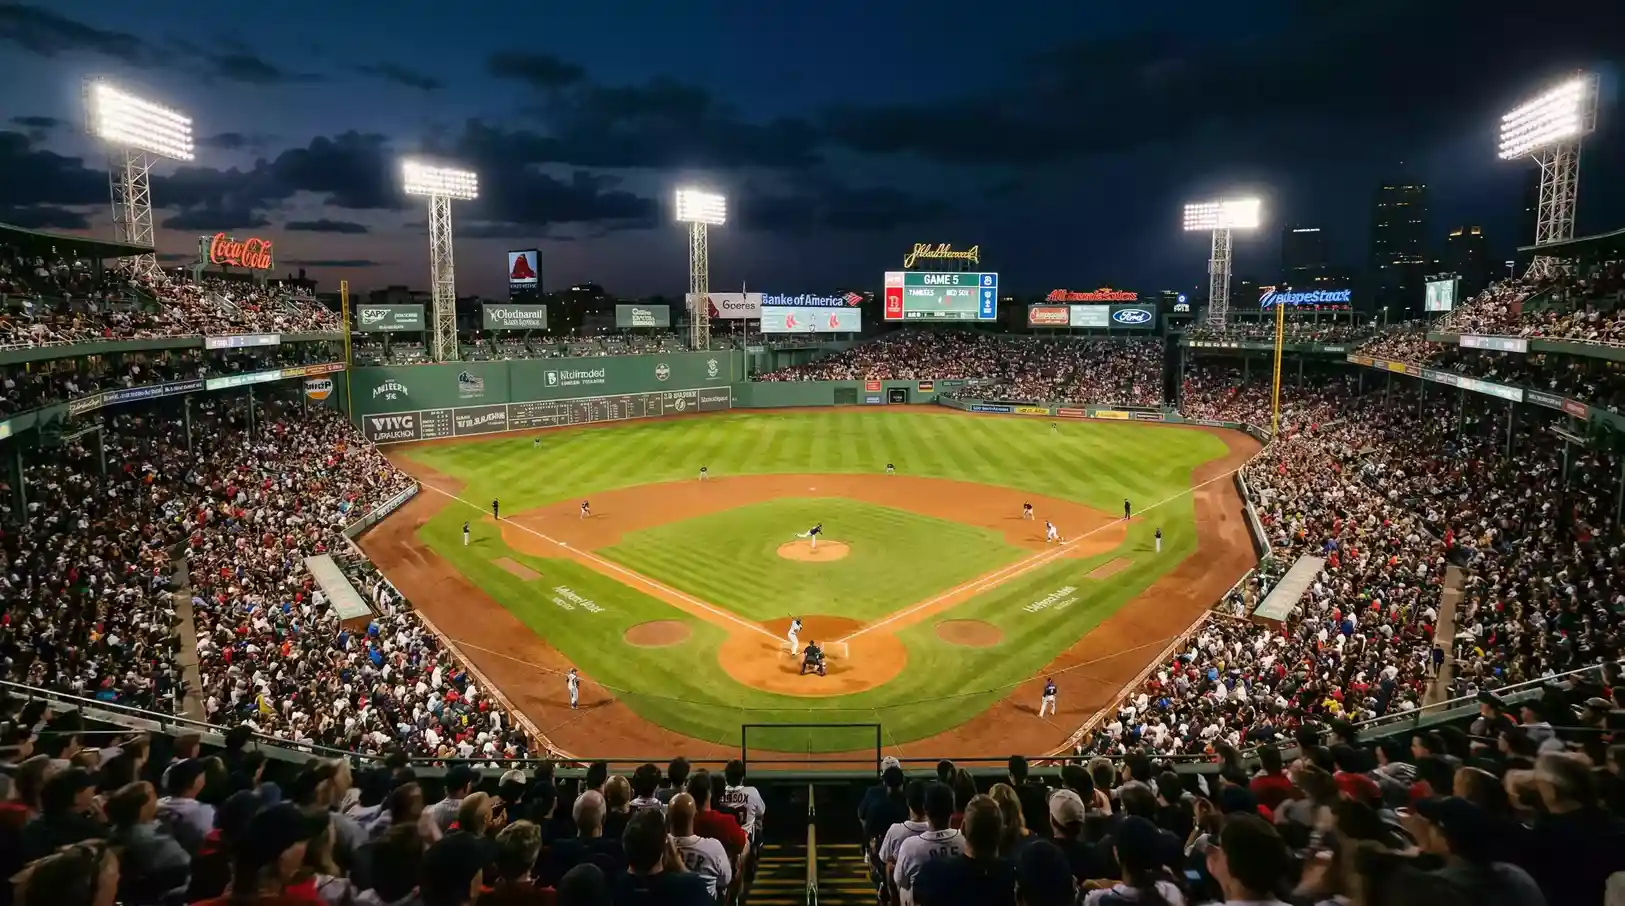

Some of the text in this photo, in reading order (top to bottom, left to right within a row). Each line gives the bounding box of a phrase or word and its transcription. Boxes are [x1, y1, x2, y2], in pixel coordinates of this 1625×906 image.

[924, 275, 959, 285] GAME 5
[794, 293, 806, 305] of
[805, 294, 843, 306] America
